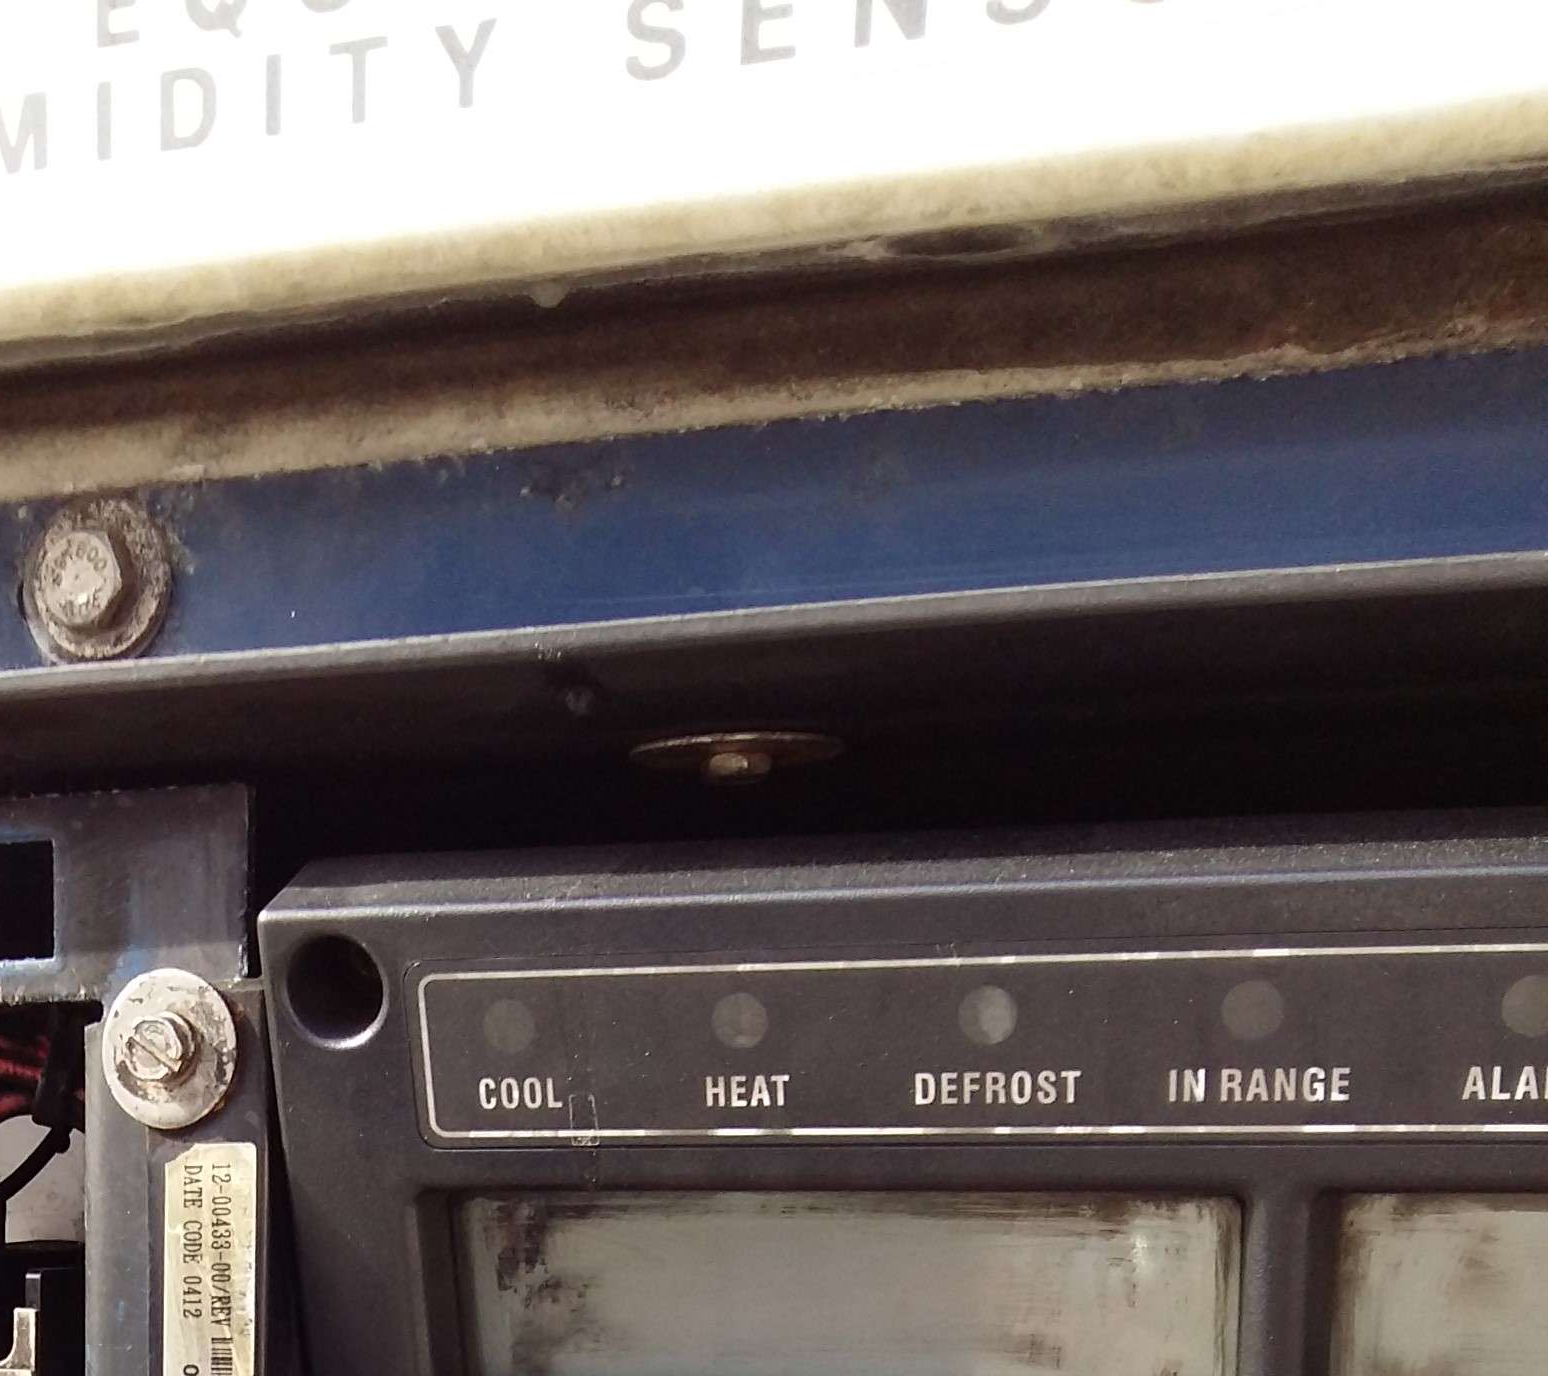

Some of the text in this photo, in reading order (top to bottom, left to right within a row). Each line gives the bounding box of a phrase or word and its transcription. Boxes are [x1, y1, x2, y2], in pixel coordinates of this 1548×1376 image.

[478, 1077, 563, 1112] COOL
[705, 1074, 790, 1109] HEAT
[913, 1069, 1082, 1107] DEFROST
[1168, 1066, 1352, 1103] IN RANGE
[1462, 1066, 1548, 1100] ALA
[183, 1165, 203, 1318] DATE CODE 0412
